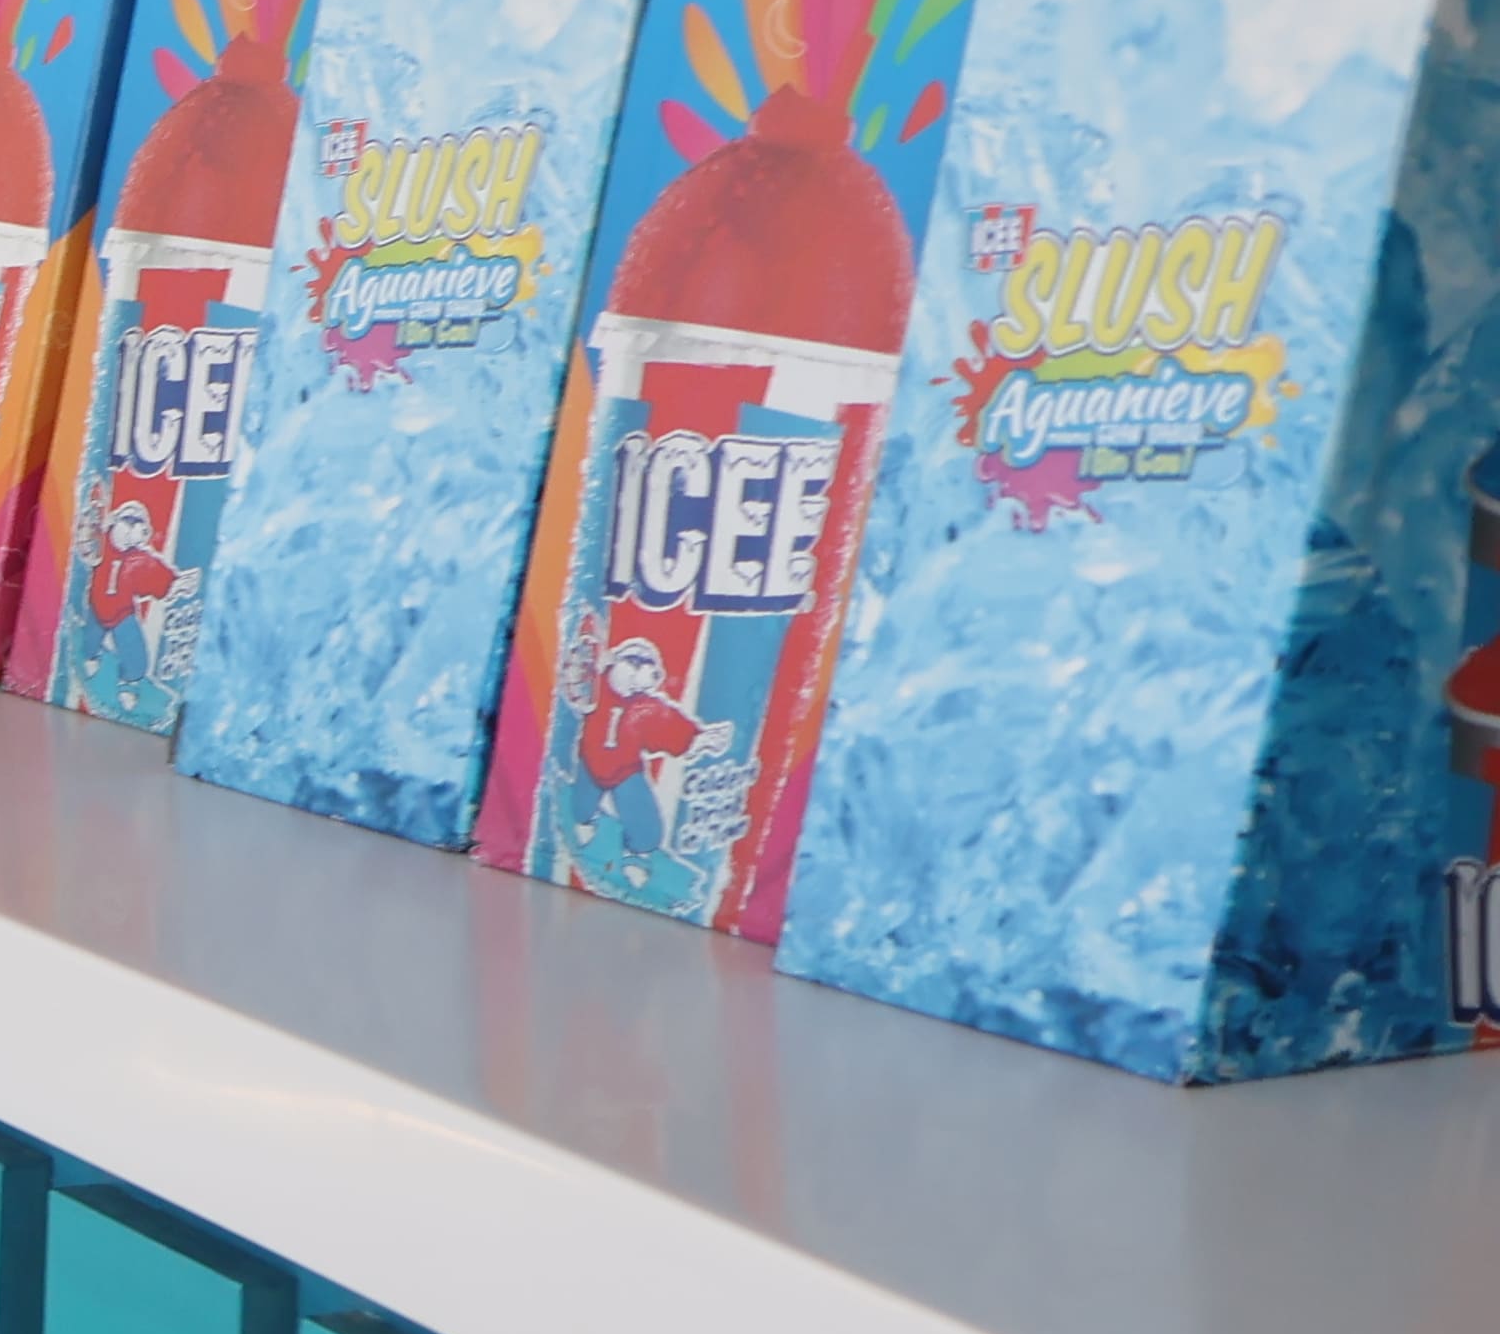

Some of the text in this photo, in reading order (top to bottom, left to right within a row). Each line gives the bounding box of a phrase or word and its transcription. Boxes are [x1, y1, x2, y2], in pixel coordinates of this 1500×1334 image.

[332, 122, 544, 249] SLUSH
[328, 247, 518, 337] Aguanieve
[989, 214, 1282, 359] SLUSH
[984, 358, 1253, 467] Aguanieve
[603, 430, 843, 617] ICEE
